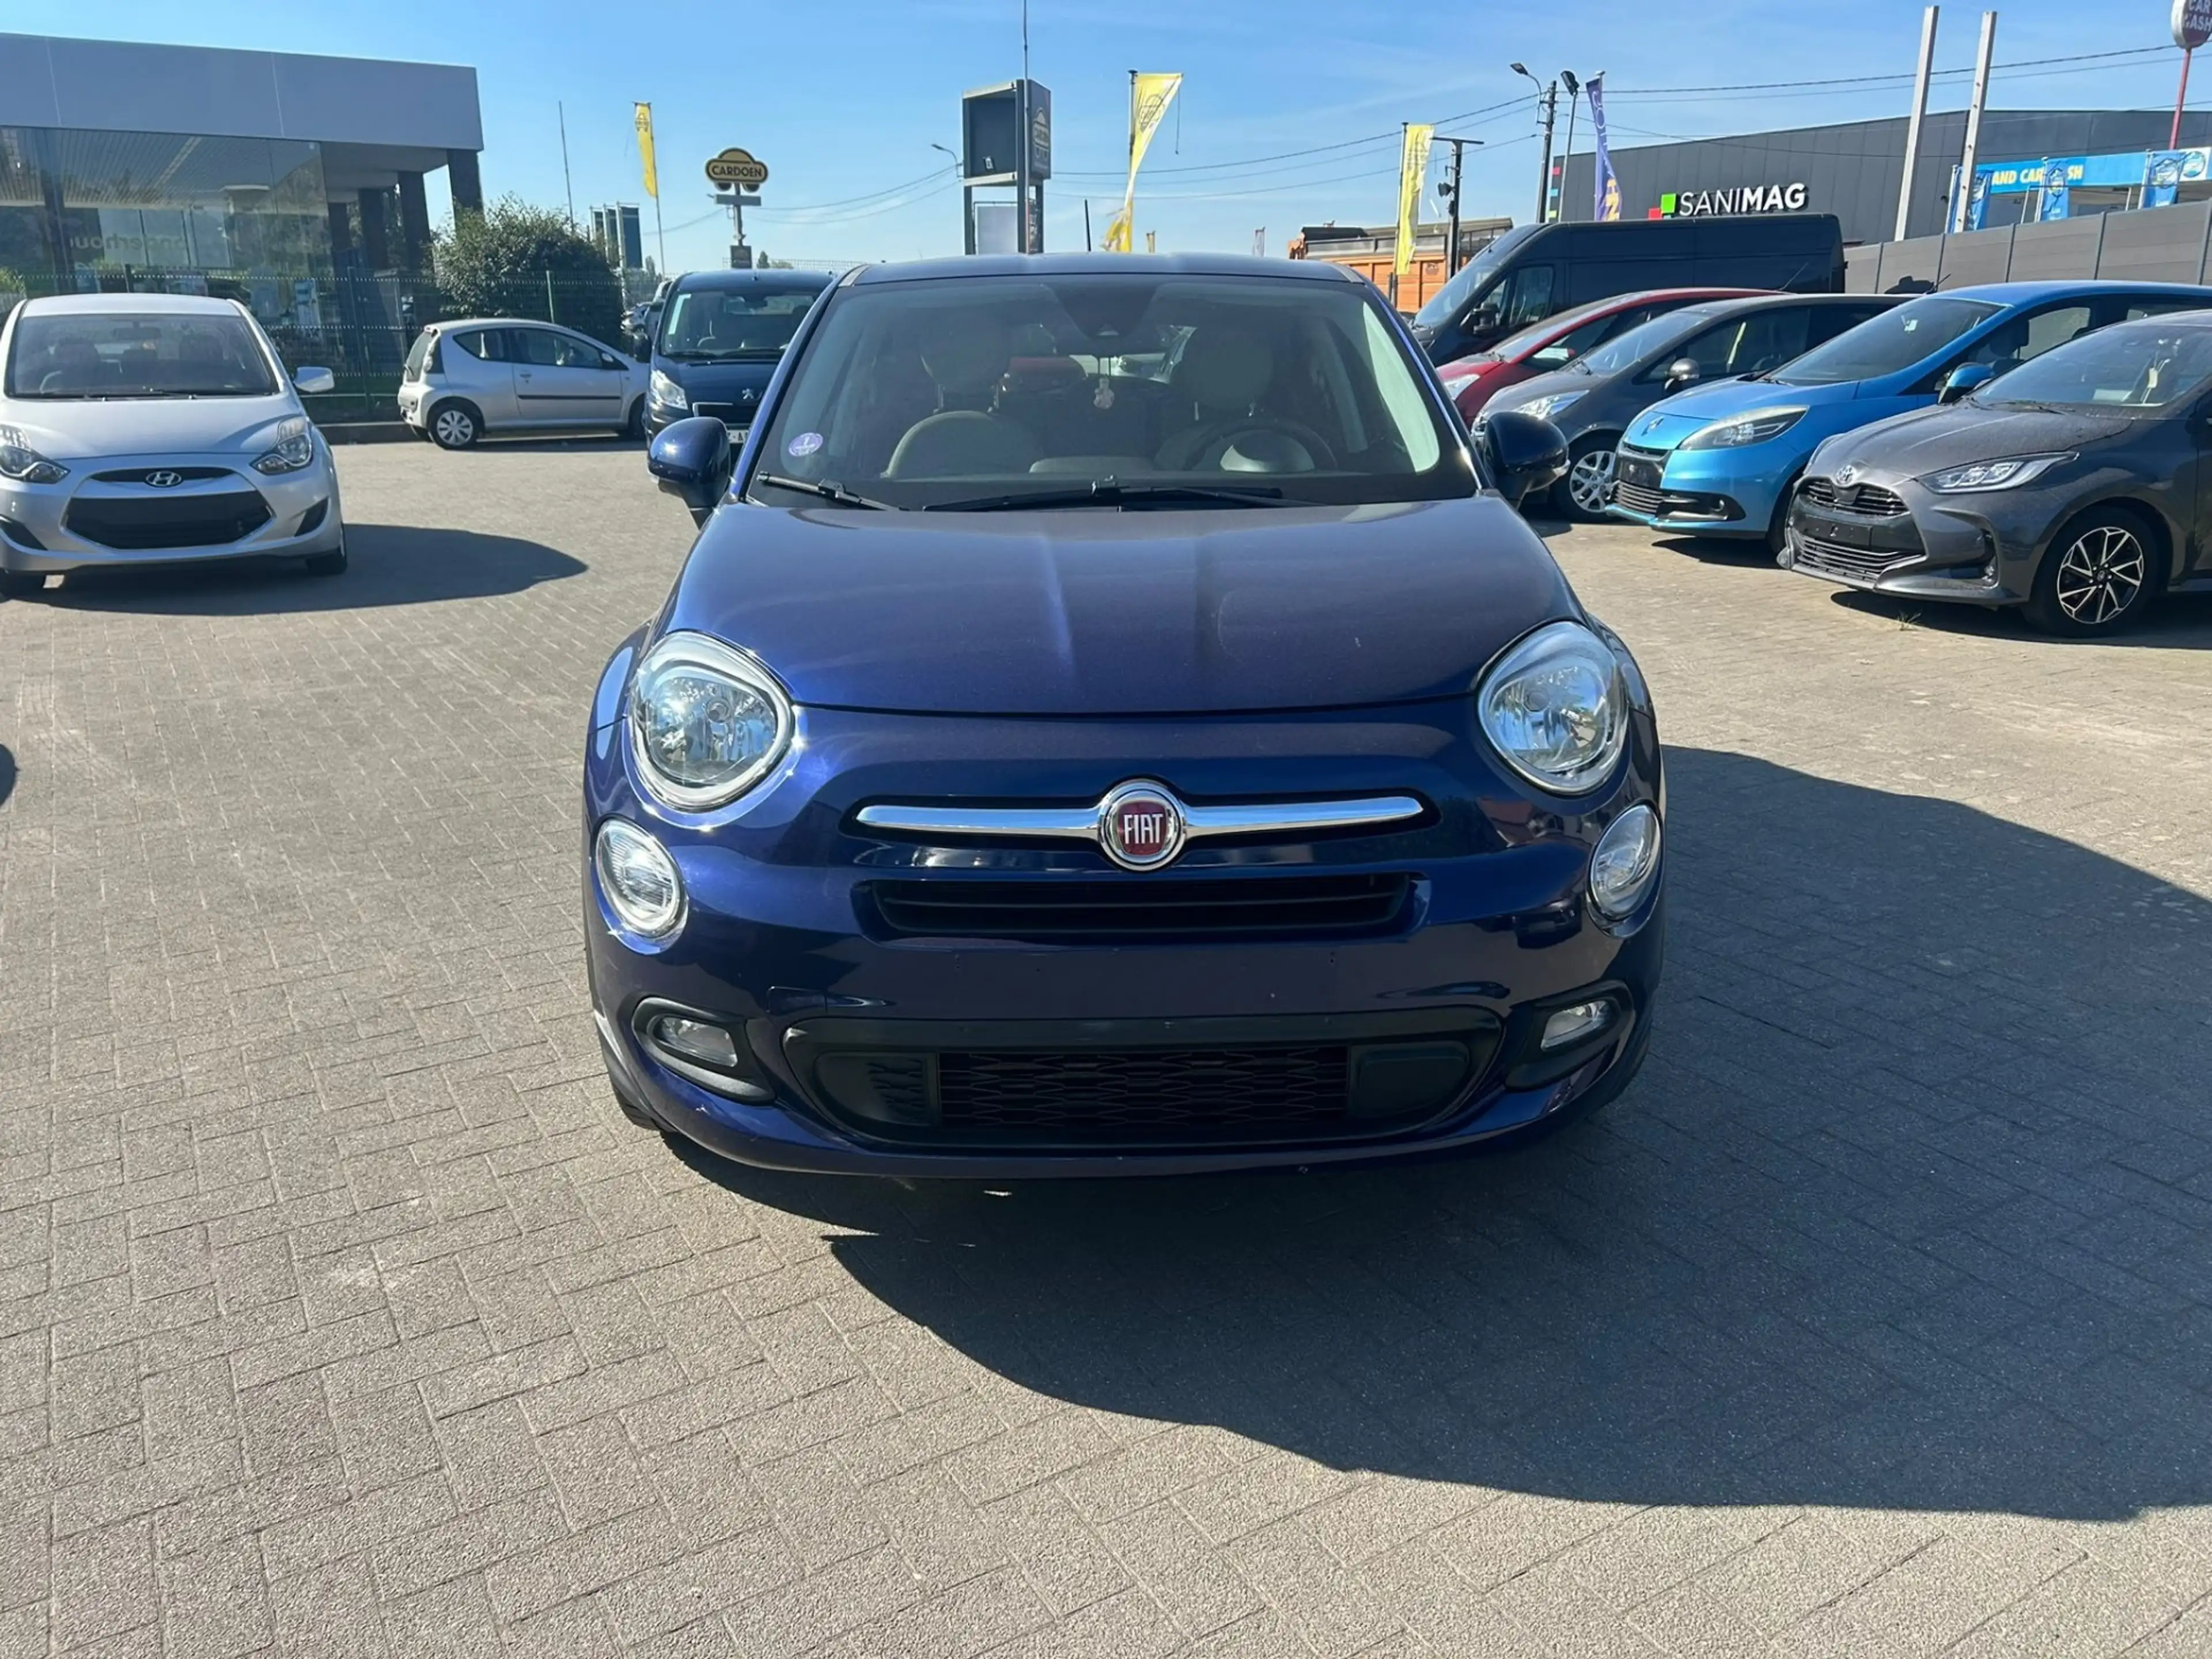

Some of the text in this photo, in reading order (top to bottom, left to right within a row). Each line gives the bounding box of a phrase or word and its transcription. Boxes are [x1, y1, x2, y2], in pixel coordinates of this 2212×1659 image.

[712, 165, 762, 177] CARDOEN
[1679, 183, 1805, 217] SANIMAG
[1124, 813, 1164, 844] FIAT
